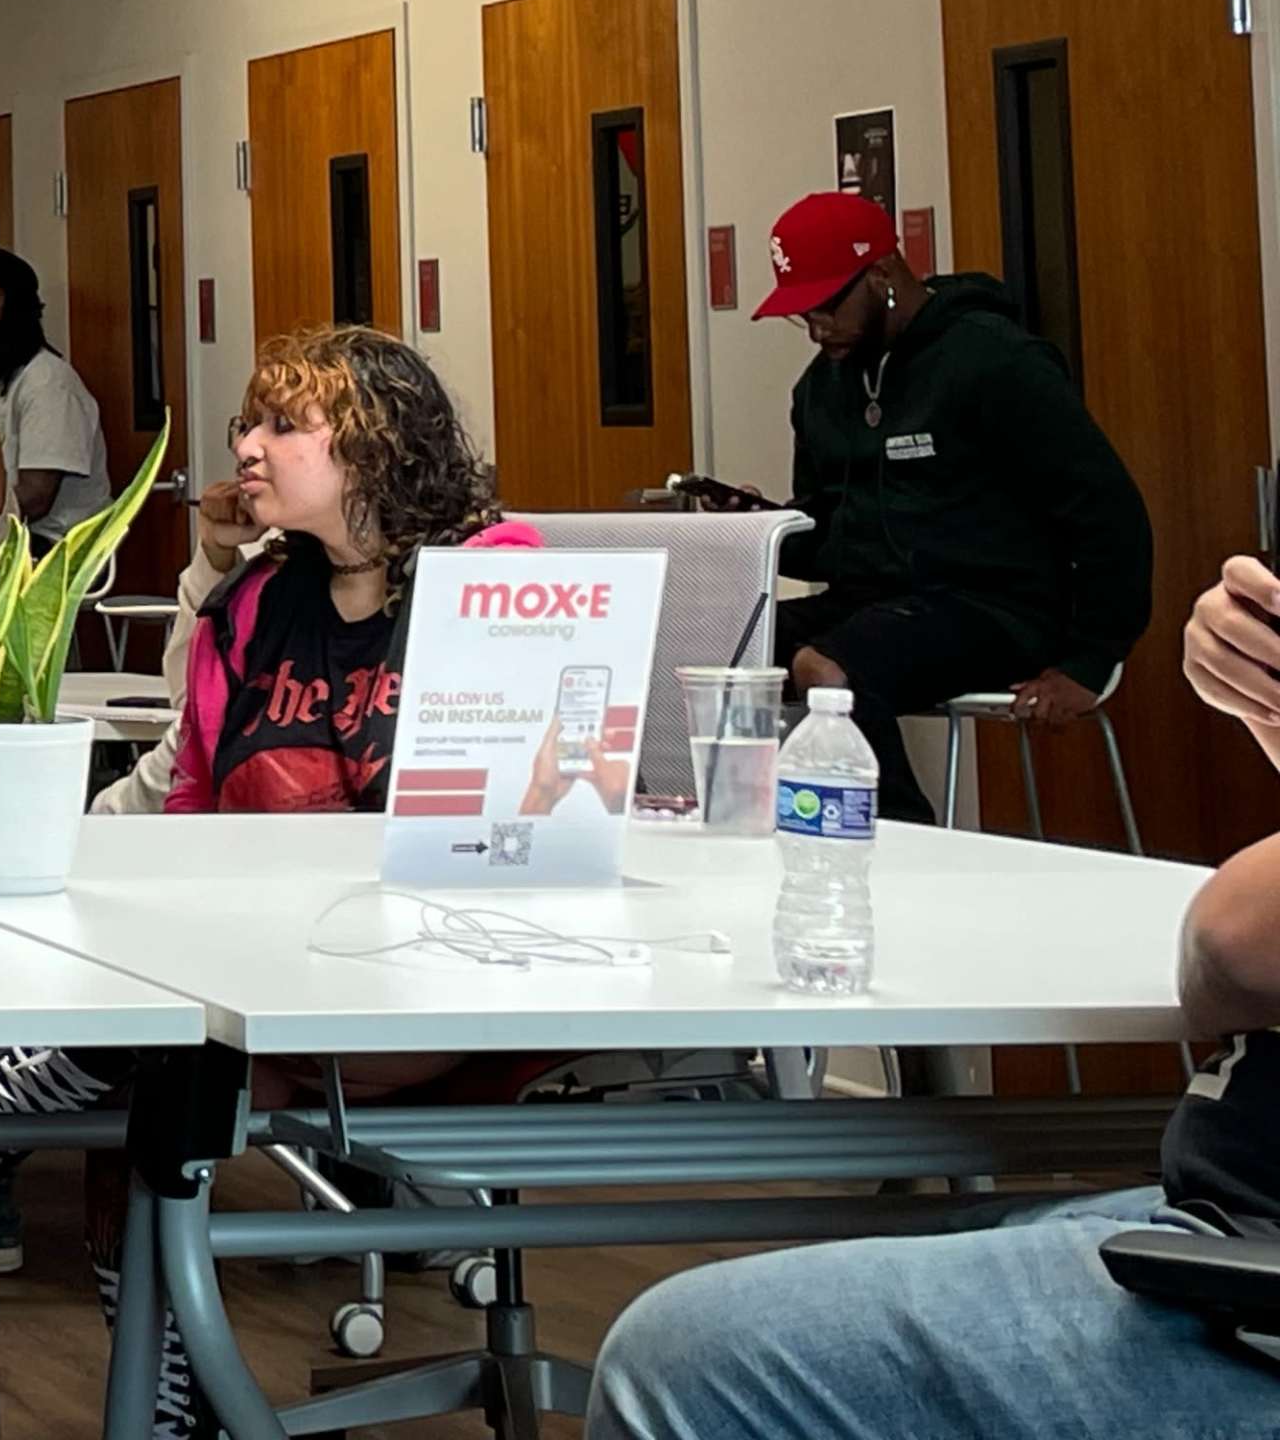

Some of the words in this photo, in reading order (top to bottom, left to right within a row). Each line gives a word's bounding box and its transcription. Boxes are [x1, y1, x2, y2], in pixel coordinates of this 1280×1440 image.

[419, 691, 482, 706] FOLLOW
[484, 691, 505, 706] US
[418, 708, 444, 724] ON
[447, 708, 544, 724] INSTAGRAM
